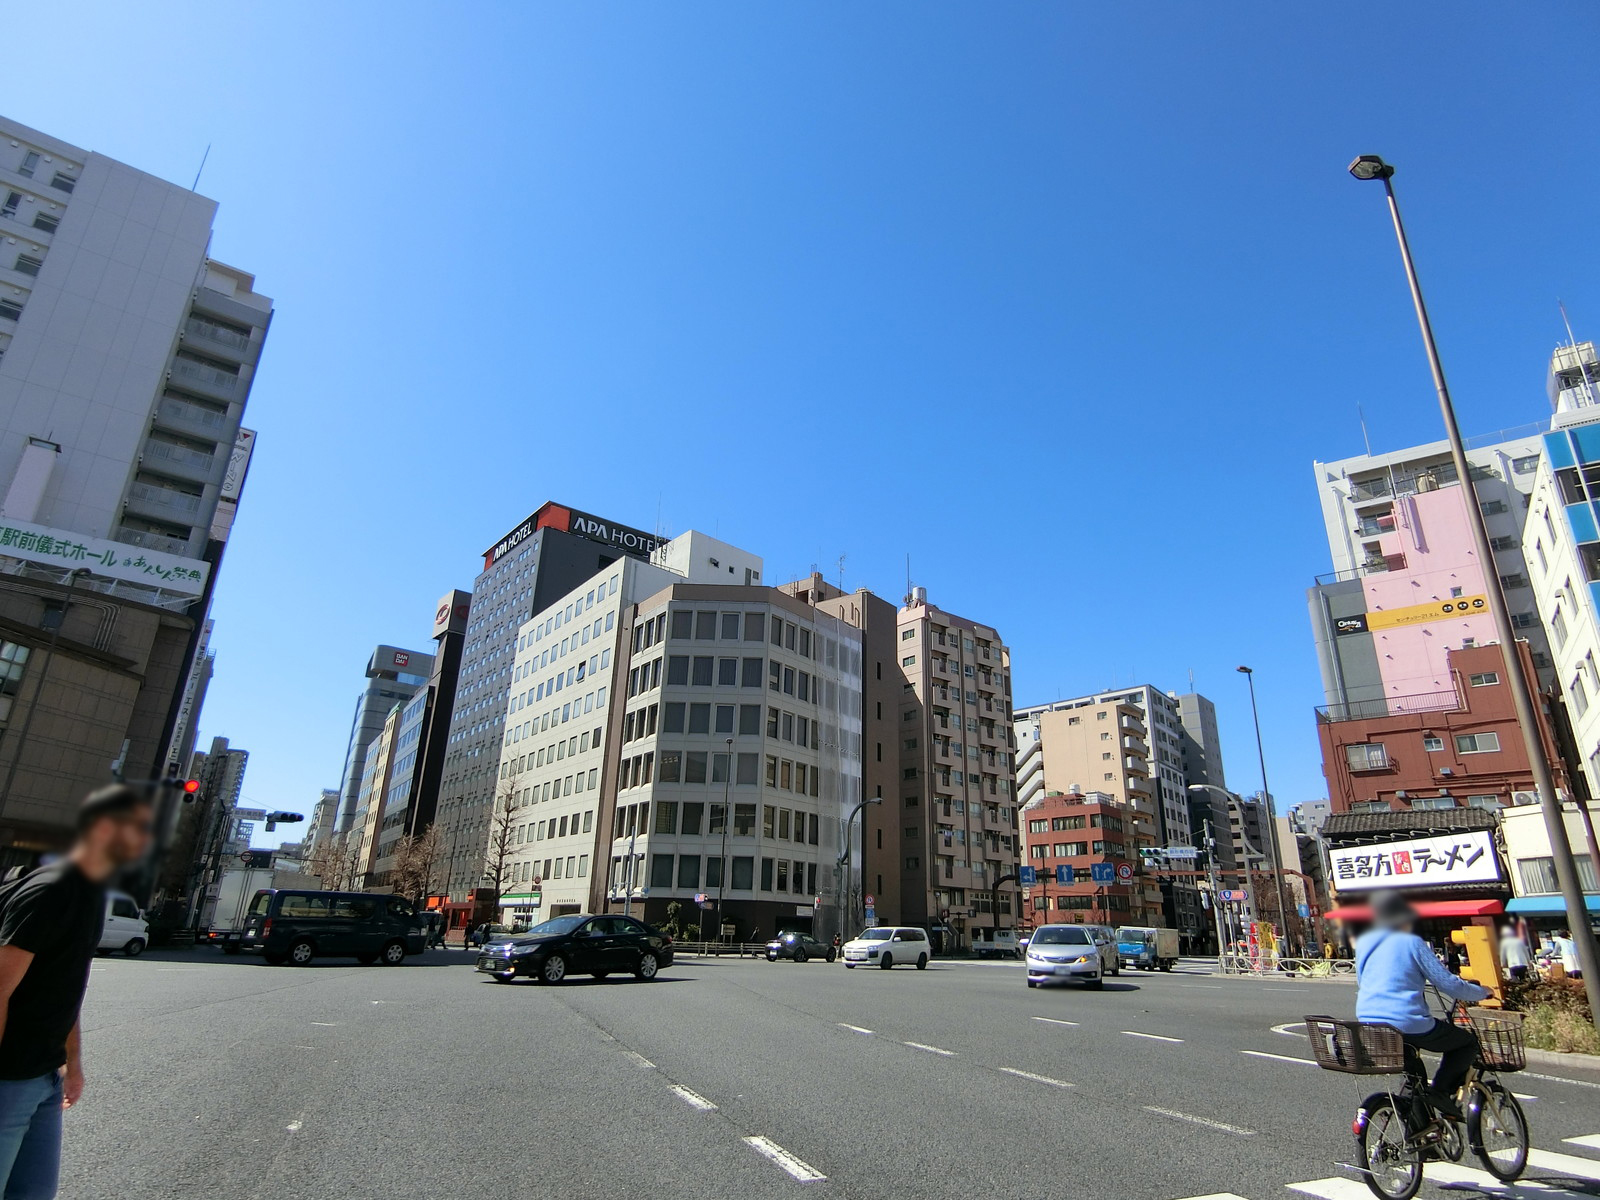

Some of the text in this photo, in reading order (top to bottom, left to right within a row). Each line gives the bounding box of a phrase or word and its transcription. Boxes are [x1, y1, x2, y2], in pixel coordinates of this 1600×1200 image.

[574, 516, 608, 539] APA
[492, 521, 532, 562] APA HOTEL
[1336, 853, 1393, 880] 喜多方
